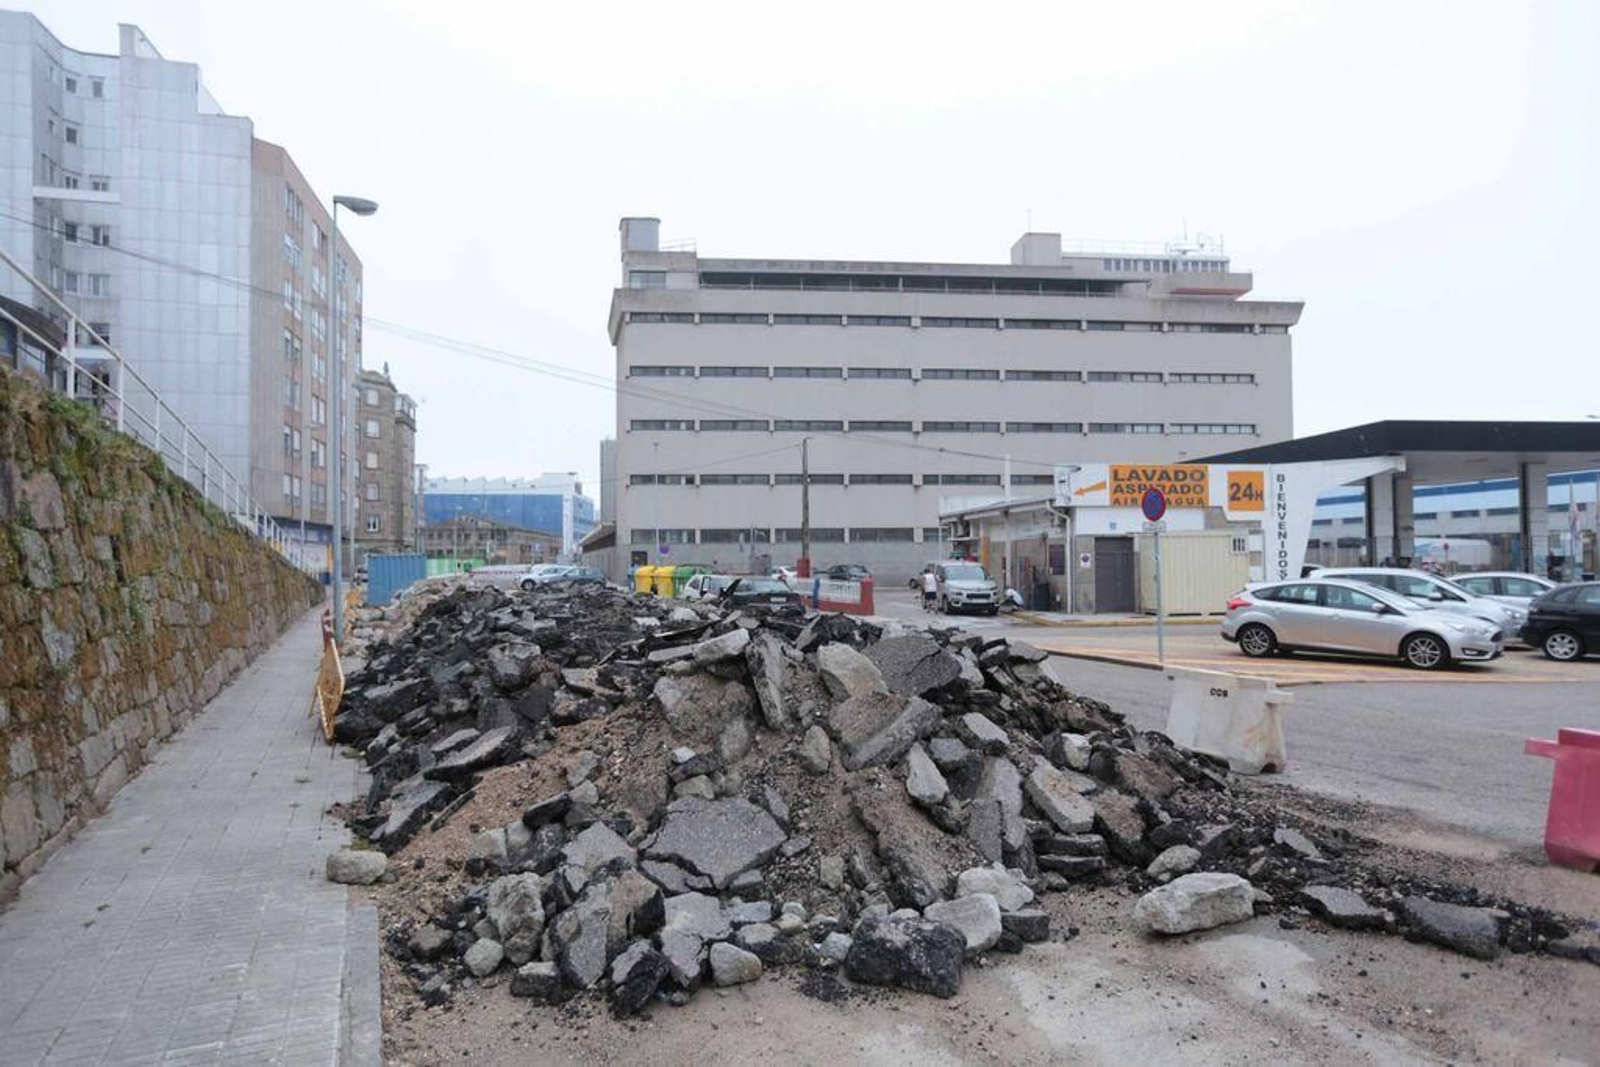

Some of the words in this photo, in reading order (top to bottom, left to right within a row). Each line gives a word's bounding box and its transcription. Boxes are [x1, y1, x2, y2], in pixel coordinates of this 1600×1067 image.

[1113, 469, 1205, 482] LAVADO
[1229, 482, 1264, 501] 24H
[1276, 474, 1288, 580] BIENVENIDOS
